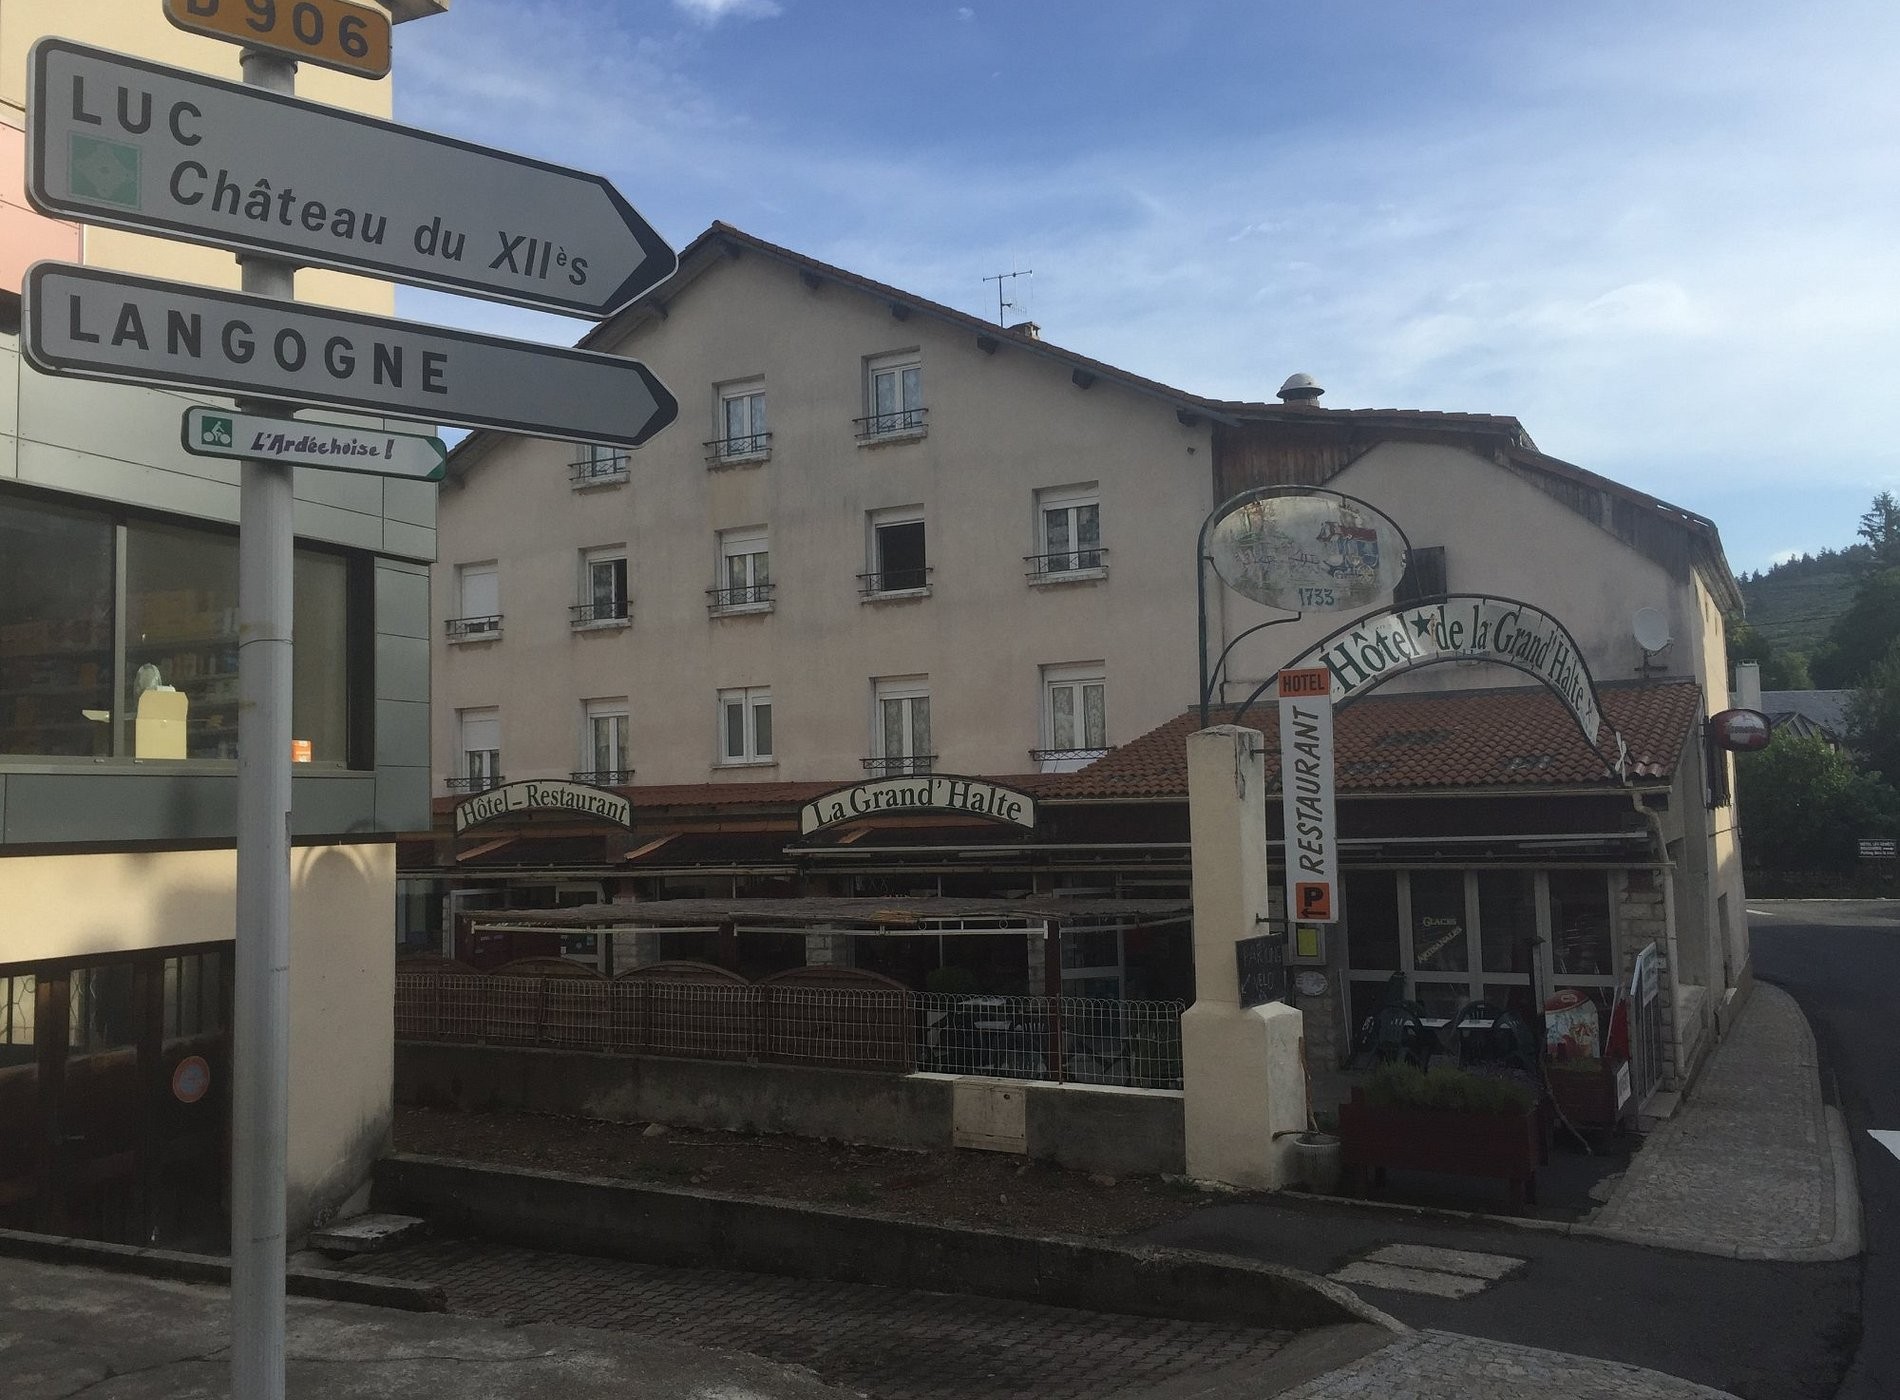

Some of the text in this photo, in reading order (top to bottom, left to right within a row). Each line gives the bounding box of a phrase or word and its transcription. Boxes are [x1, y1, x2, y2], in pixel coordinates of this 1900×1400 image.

[72, 75, 202, 146] LUC
[169, 160, 387, 245] Château
[413, 216, 466, 262] du
[69, 294, 448, 395] LANGOGNE
[1298, 587, 1335, 606] 1733
[1282, 673, 1325, 693] HOTEL
[1319, 612, 1421, 694] Hôtel
[1434, 605, 1464, 651] de
[1471, 604, 1489, 651] la
[810, 800, 846, 827] La
[1292, 704, 1325, 875] RESTAURANT
[1303, 886, 1324, 907] P
